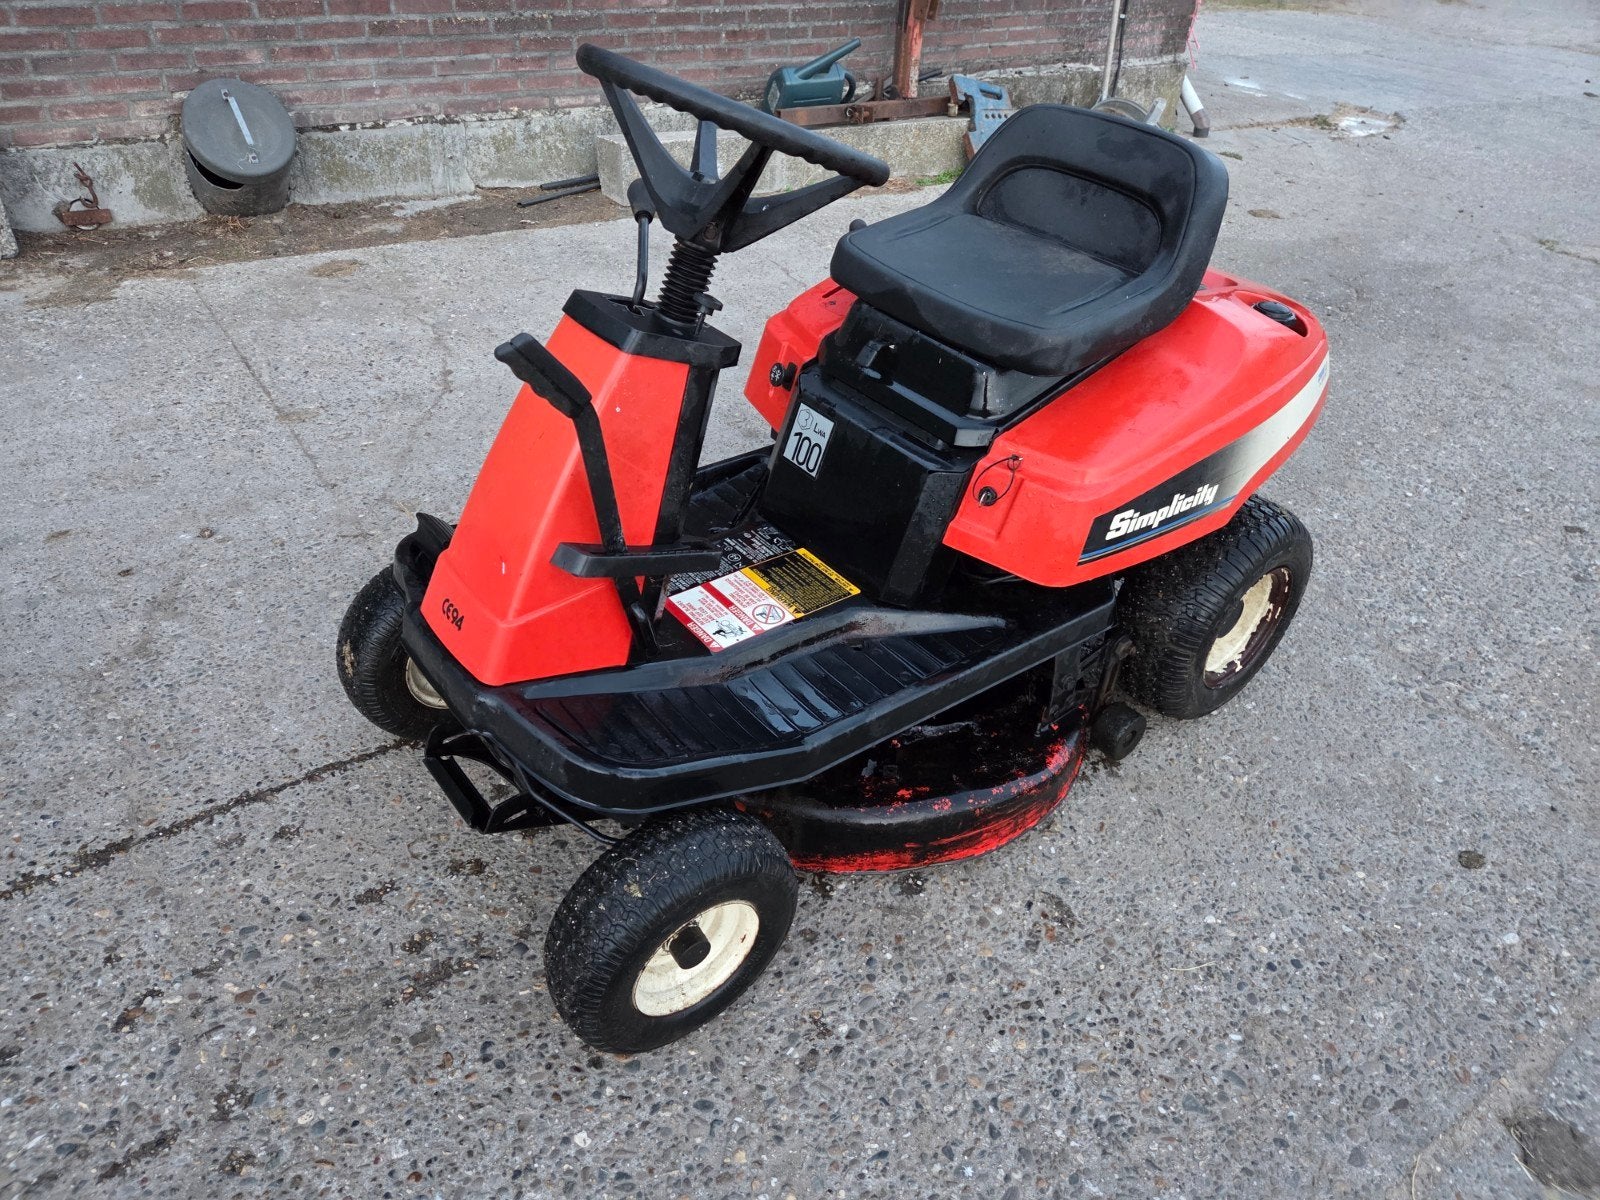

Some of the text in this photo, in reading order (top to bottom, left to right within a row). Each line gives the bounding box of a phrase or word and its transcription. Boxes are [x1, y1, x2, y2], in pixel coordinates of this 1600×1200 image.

[791, 431, 822, 473] 100
[1105, 483, 1219, 541] Simplicity
[765, 586, 794, 609] WARNING
[727, 604, 754, 625] DANGER
[686, 621, 712, 643] DANGER
